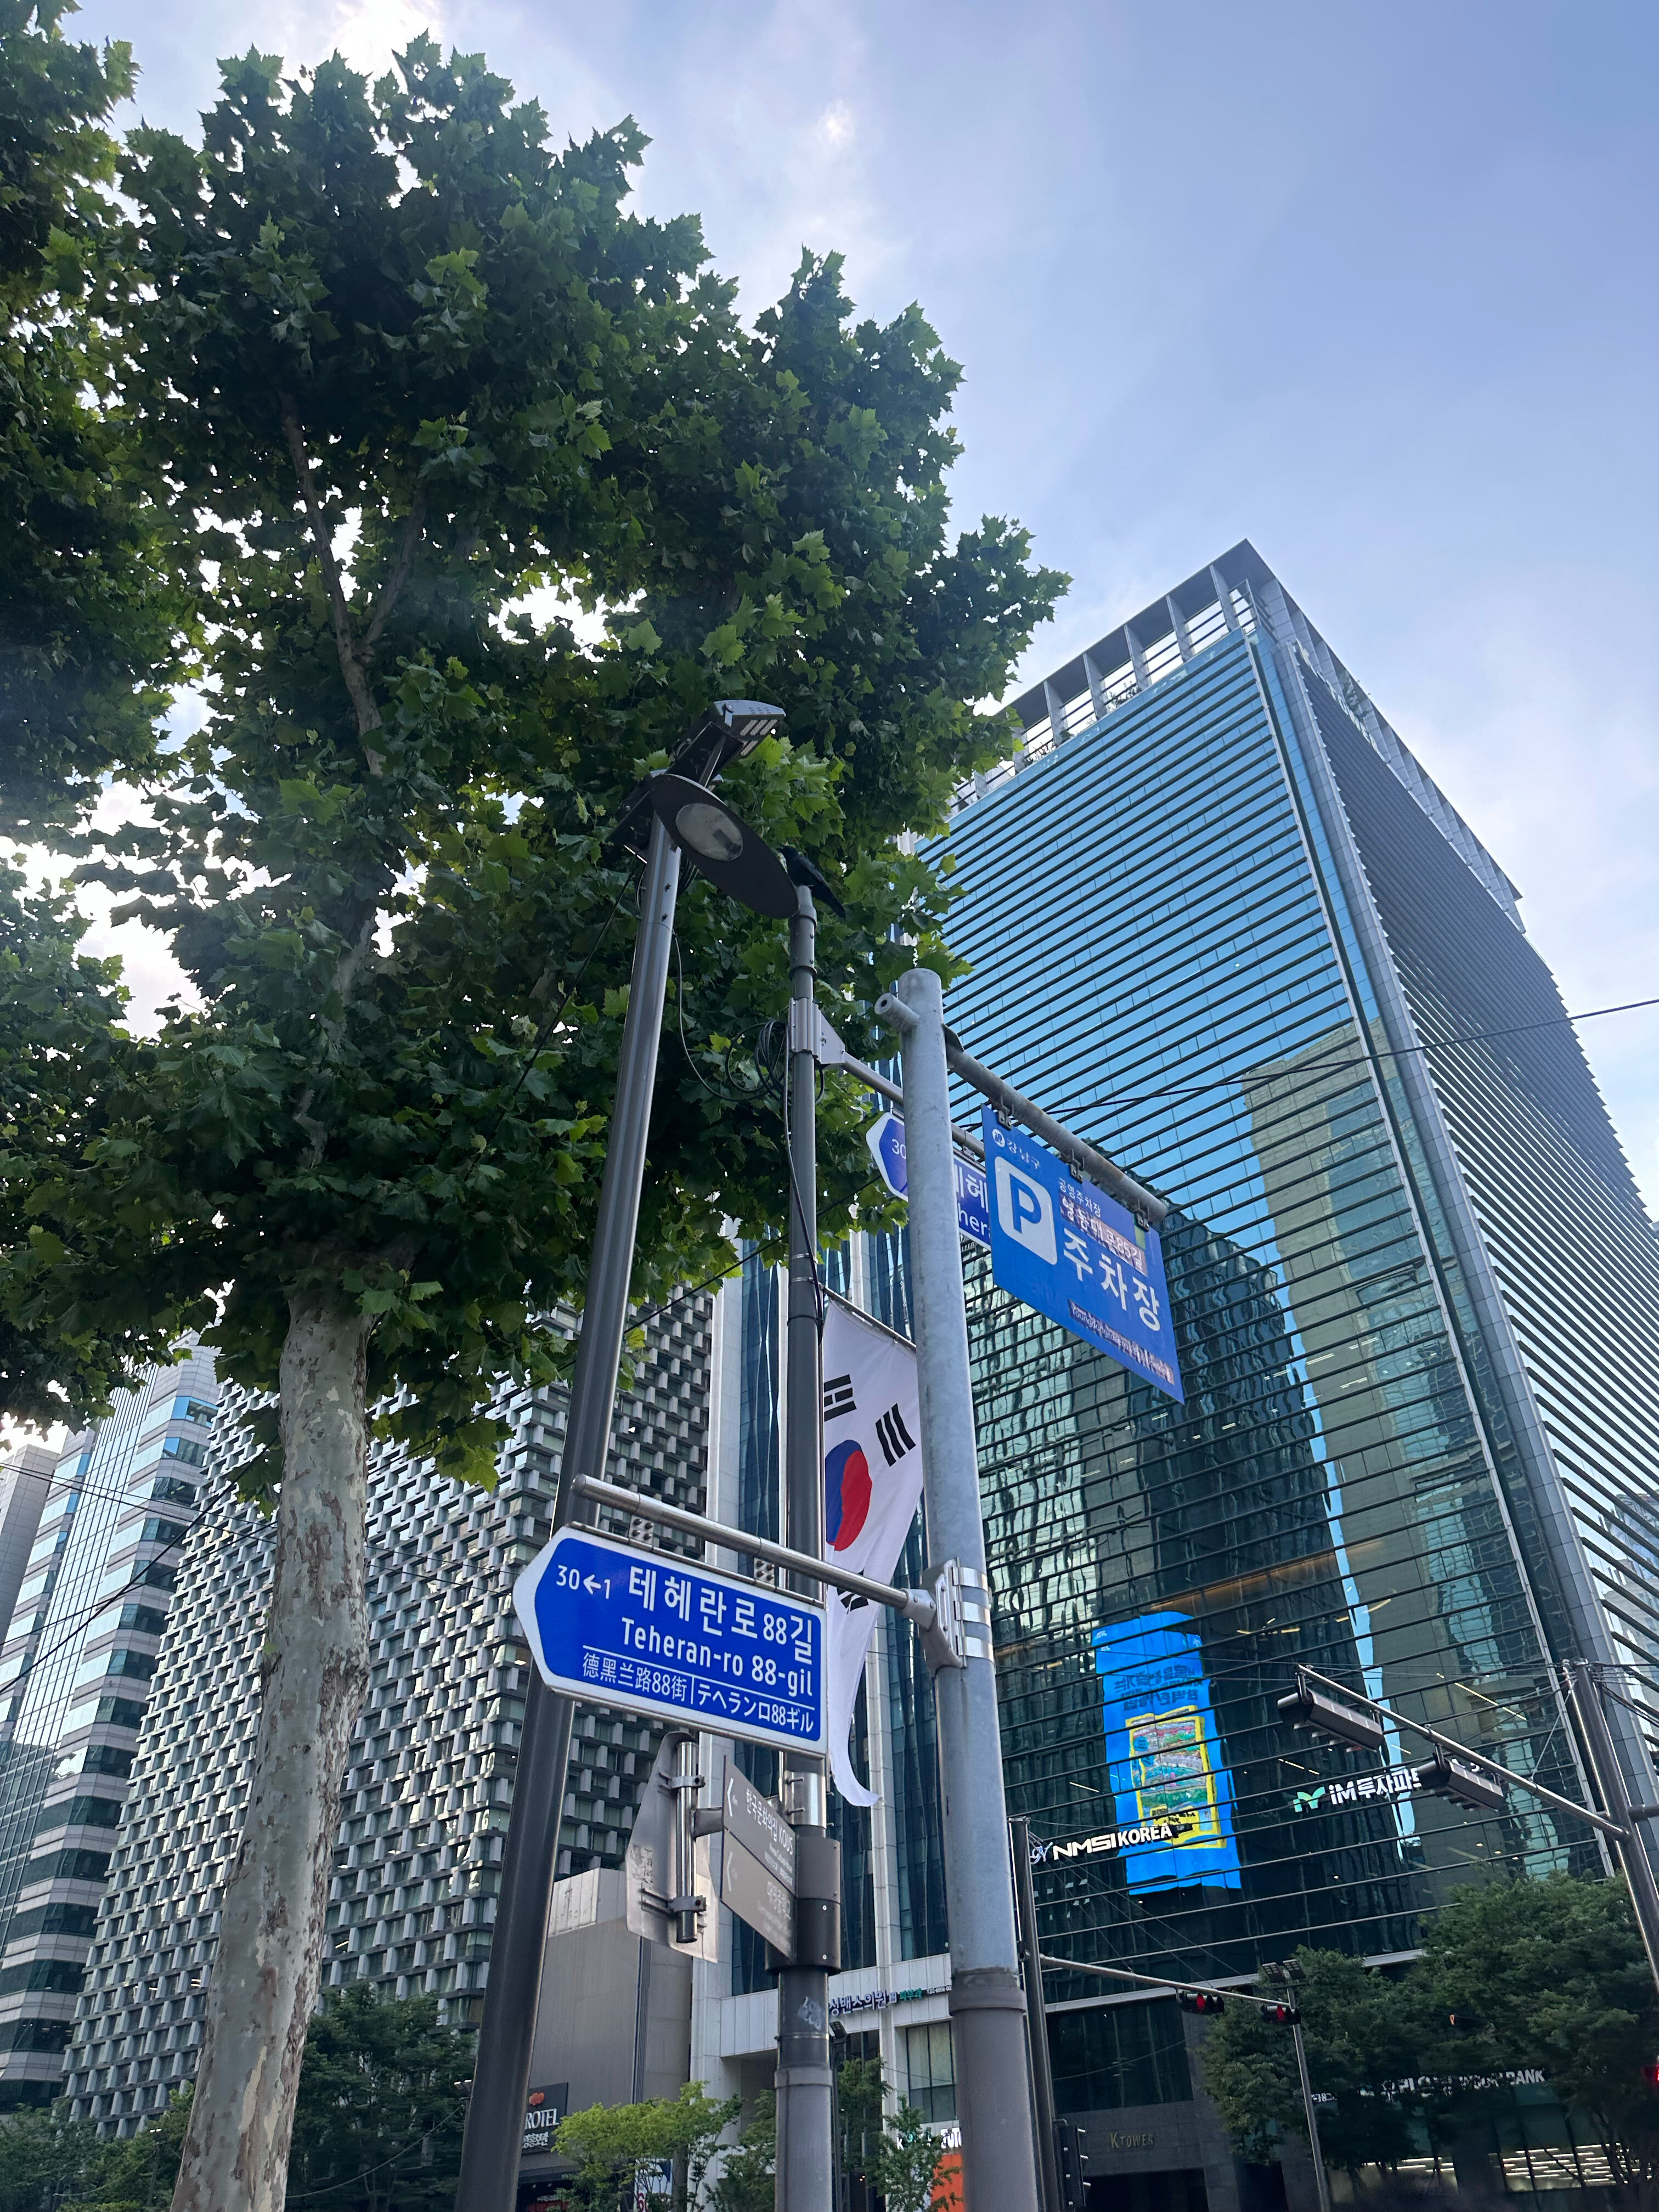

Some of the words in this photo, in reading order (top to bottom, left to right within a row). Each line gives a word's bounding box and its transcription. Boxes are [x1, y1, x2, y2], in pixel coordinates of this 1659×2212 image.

[1006, 1138, 1041, 1170] 강남구
[1009, 1173, 1042, 1234] P
[1059, 1177, 1101, 1218] 공영주차장
[1063, 1228, 1160, 1331] 주차장
[556, 1565, 580, 1590] 30
[629, 1566, 812, 1666] 테헤란로88길
[583, 1652, 687, 1702] 德黑兰路88街
[622, 1617, 743, 1677] Teheran-ro
[752, 1656, 812, 1697] 88-gil
[697, 1683, 814, 1733] テヘランロ88ギル
[746, 1788, 778, 1842] 한국문화의집
[779, 1825, 793, 1855] KOUS
[1053, 1833, 1116, 1860] NMSI
[1118, 1822, 1173, 1847] KOREA
[899, 1988, 922, 2001] 피부과
